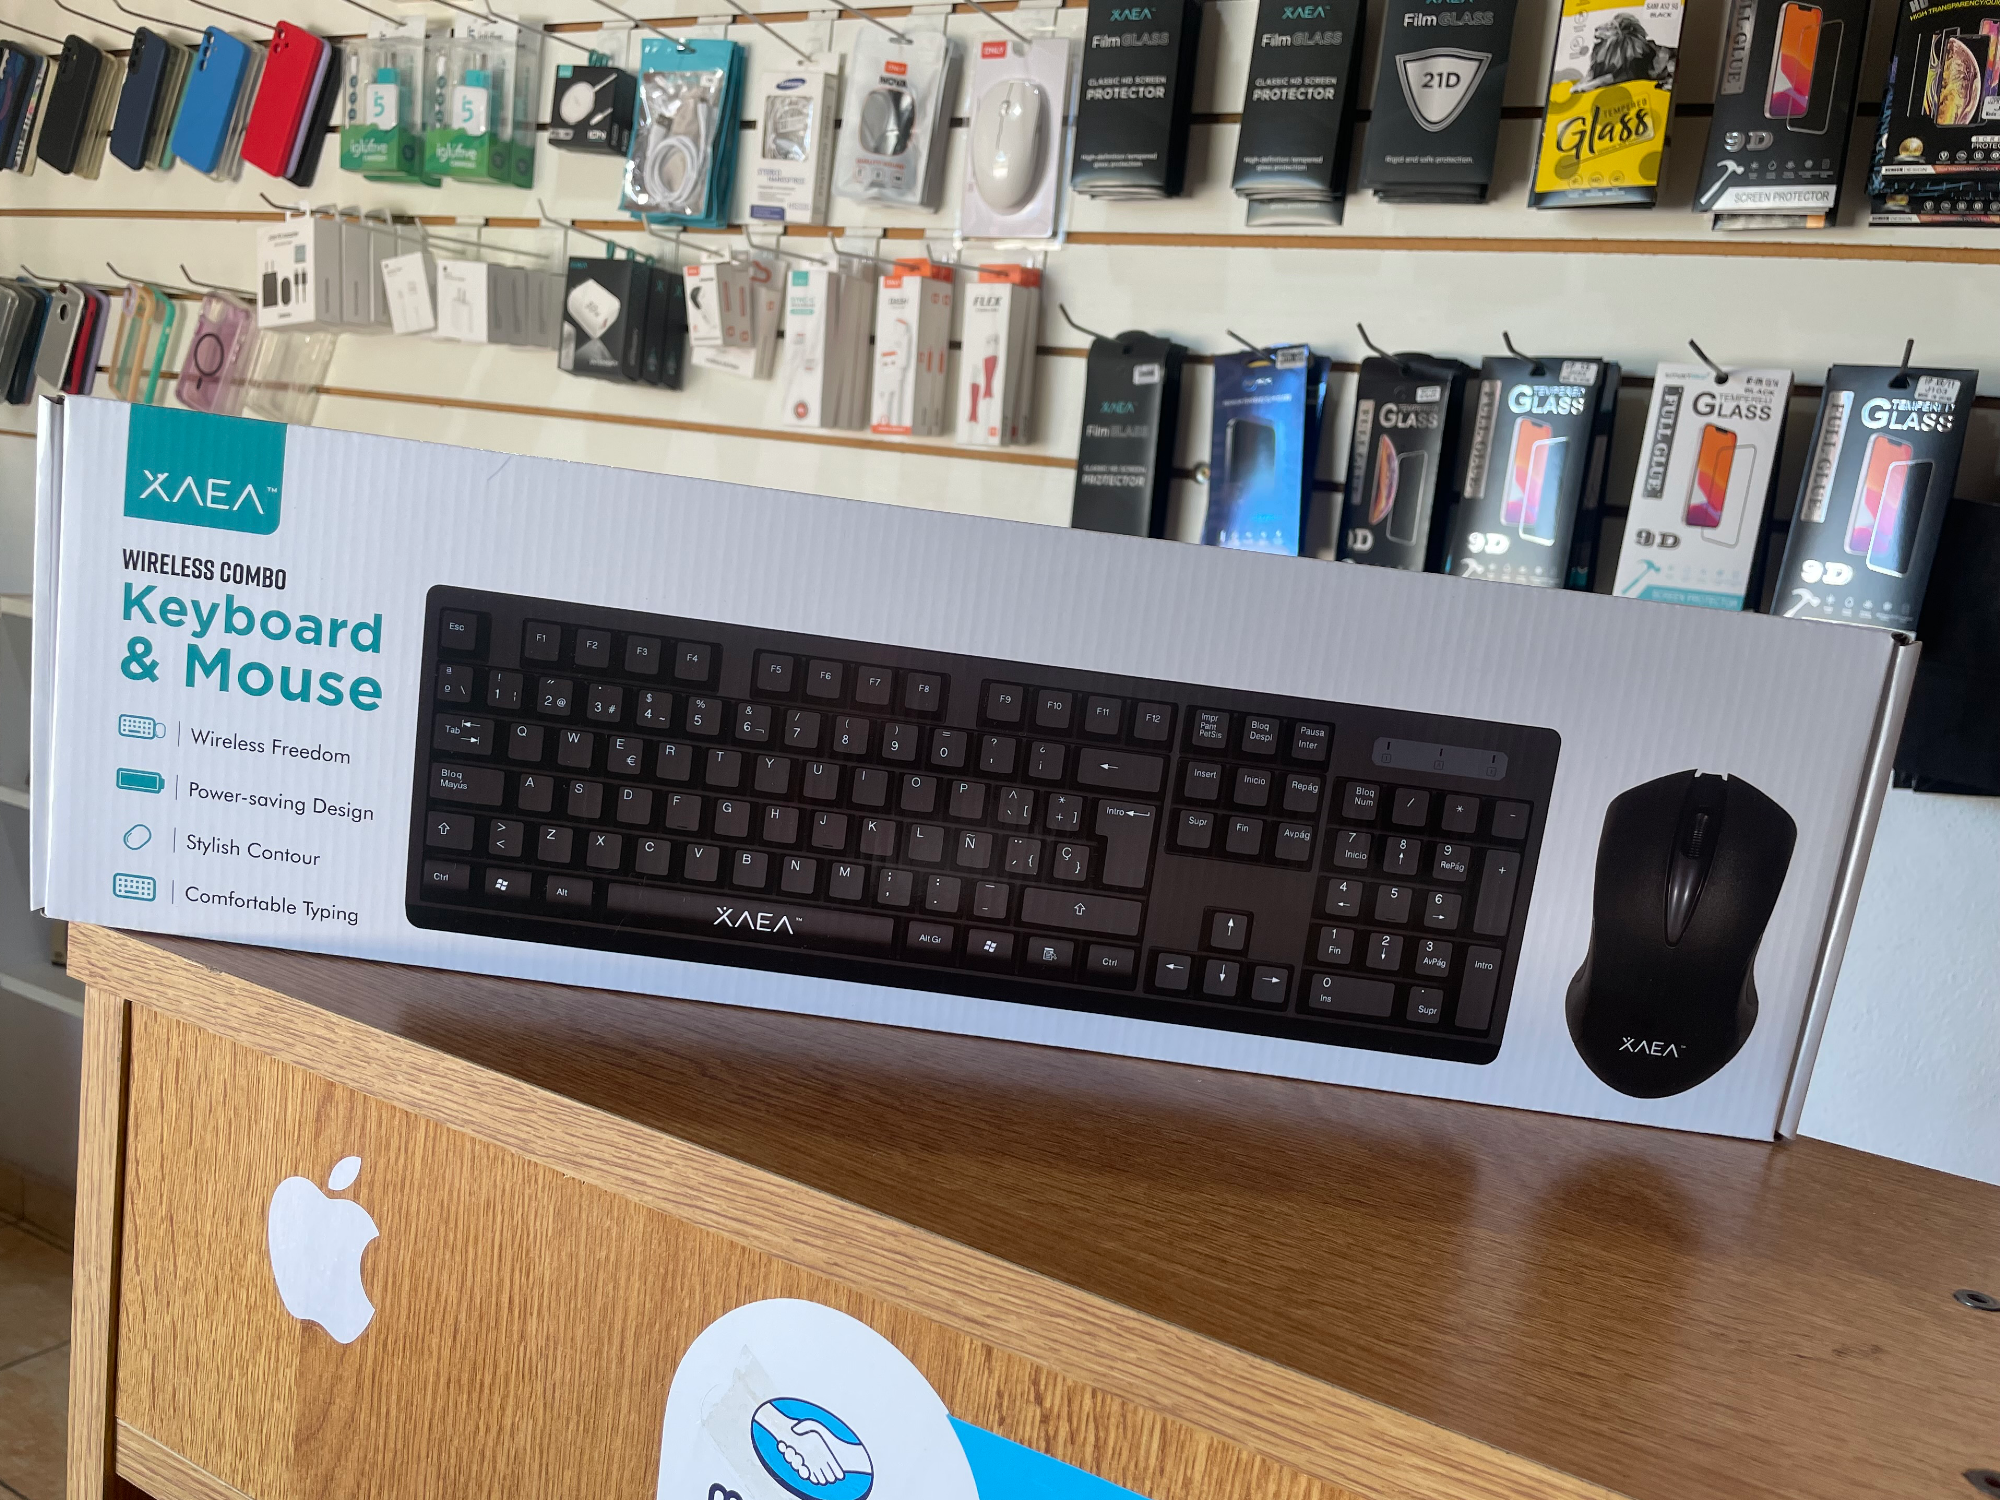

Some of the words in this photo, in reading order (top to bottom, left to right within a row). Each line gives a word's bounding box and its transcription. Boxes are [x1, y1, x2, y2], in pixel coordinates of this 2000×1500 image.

[1910, 8, 1927, 21] HIGH
[1422, 72, 1461, 89] 21D
[1085, 86, 1166, 101] PROTECTOR
[1252, 87, 1335, 102] PROTECTOR
[1603, 97, 1648, 118] TEMPERED
[1556, 105, 1649, 160] Glass
[1724, 130, 1774, 153] 9D
[1734, 190, 1772, 204] SCREEN
[1773, 189, 1830, 203] PROTECTOR
[1508, 384, 1585, 416] GLASS
[1692, 390, 1772, 422] GLASS
[1379, 402, 1439, 429] GLASS
[1656, 394, 1680, 441] FULL
[1861, 397, 1956, 433] GLASS
[1646, 443, 1668, 492] GLUE
[1635, 528, 1681, 550] 9D
[122, 548, 214, 581] WIRELESS
[220, 561, 287, 590] COMBO
[123, 582, 383, 654] Keyboard
[449, 622, 465, 632] Esc
[536, 633, 546, 643] F1
[586, 640, 598, 650] F2
[636, 646, 648, 656] F3
[686, 653, 698, 663] F4
[121, 636, 160, 682] &
[186, 643, 383, 712] Mouse
[770, 664, 782, 674] F5
[820, 671, 832, 680] F6
[869, 677, 881, 687] F7
[918, 684, 930, 693] F8
[999, 694, 1012, 704] F9
[1047, 700, 1063, 710] F10
[1096, 707, 1110, 716] F11
[1201, 712, 1219, 723] Impr
[1145, 713, 1161, 723] F12
[445, 724, 461, 735] Tab
[516, 725, 528, 737] Q
[1251, 720, 1270, 732] Bloq
[1300, 726, 1325, 737] Pausa
[567, 731, 581, 744] W
[1249, 730, 1273, 743] Despl
[191, 728, 265, 754] Wireless
[273, 739, 351, 765] Freedom
[665, 744, 676, 756] R
[1298, 739, 1318, 750] Inter
[715, 751, 725, 762] T
[765, 757, 775, 769] Y
[813, 763, 823, 775] U
[441, 768, 463, 780] Bloq
[1194, 768, 1217, 779] Insert
[1244, 774, 1266, 785] Inicio
[440, 779, 468, 790] Mayús
[524, 776, 535, 788] A
[911, 776, 921, 788] O
[959, 782, 969, 794] P
[1291, 780, 1319, 794] Repág
[574, 783, 584, 794] S
[623, 788, 633, 800] D
[1355, 787, 1375, 798] Bloq
[190, 782, 306, 816] Power-saving
[314, 798, 374, 823] Design
[672, 795, 682, 806] F
[1354, 797, 1374, 807] Num
[722, 802, 732, 813] G
[770, 808, 780, 819] H
[1106, 806, 1125, 817] Intro
[868, 820, 877, 832] K
[1188, 815, 1208, 827] Supr
[916, 826, 924, 838] L
[1236, 822, 1249, 833] Fin
[546, 828, 557, 840] Z
[595, 834, 606, 846] X
[1283, 828, 1311, 842] Avpág
[1348, 832, 1357, 843] 7
[644, 841, 655, 852] C
[964, 833, 976, 849] Ñ
[1399, 839, 1407, 850] 8
[187, 834, 240, 856] Stylish
[248, 843, 321, 866] Contour
[694, 847, 704, 858] V
[1345, 849, 1368, 860] Inicio
[1443, 844, 1452, 856] 9
[742, 853, 752, 865] B
[790, 859, 801, 871] N
[839, 865, 851, 878] M
[1440, 860, 1465, 873] RePág
[433, 872, 449, 881] Ctrl
[556, 887, 568, 897] Alt
[1339, 881, 1348, 892] 4
[1390, 887, 1399, 899] 5
[1434, 893, 1443, 905] 6
[185, 886, 297, 915] Comfortable
[303, 901, 359, 927] Typing
[918, 933, 930, 943] Alt
[931, 934, 942, 944] Gr
[1381, 935, 1391, 946] 2
[1328, 945, 1341, 955] Fin
[1425, 940, 1434, 952] 3
[1102, 957, 1118, 967] Ctrl
[1422, 956, 1447, 969] AvPág
[1474, 960, 1493, 970] Intro
[1320, 993, 1332, 1003] Ins
[1417, 1004, 1438, 1016] Supr
